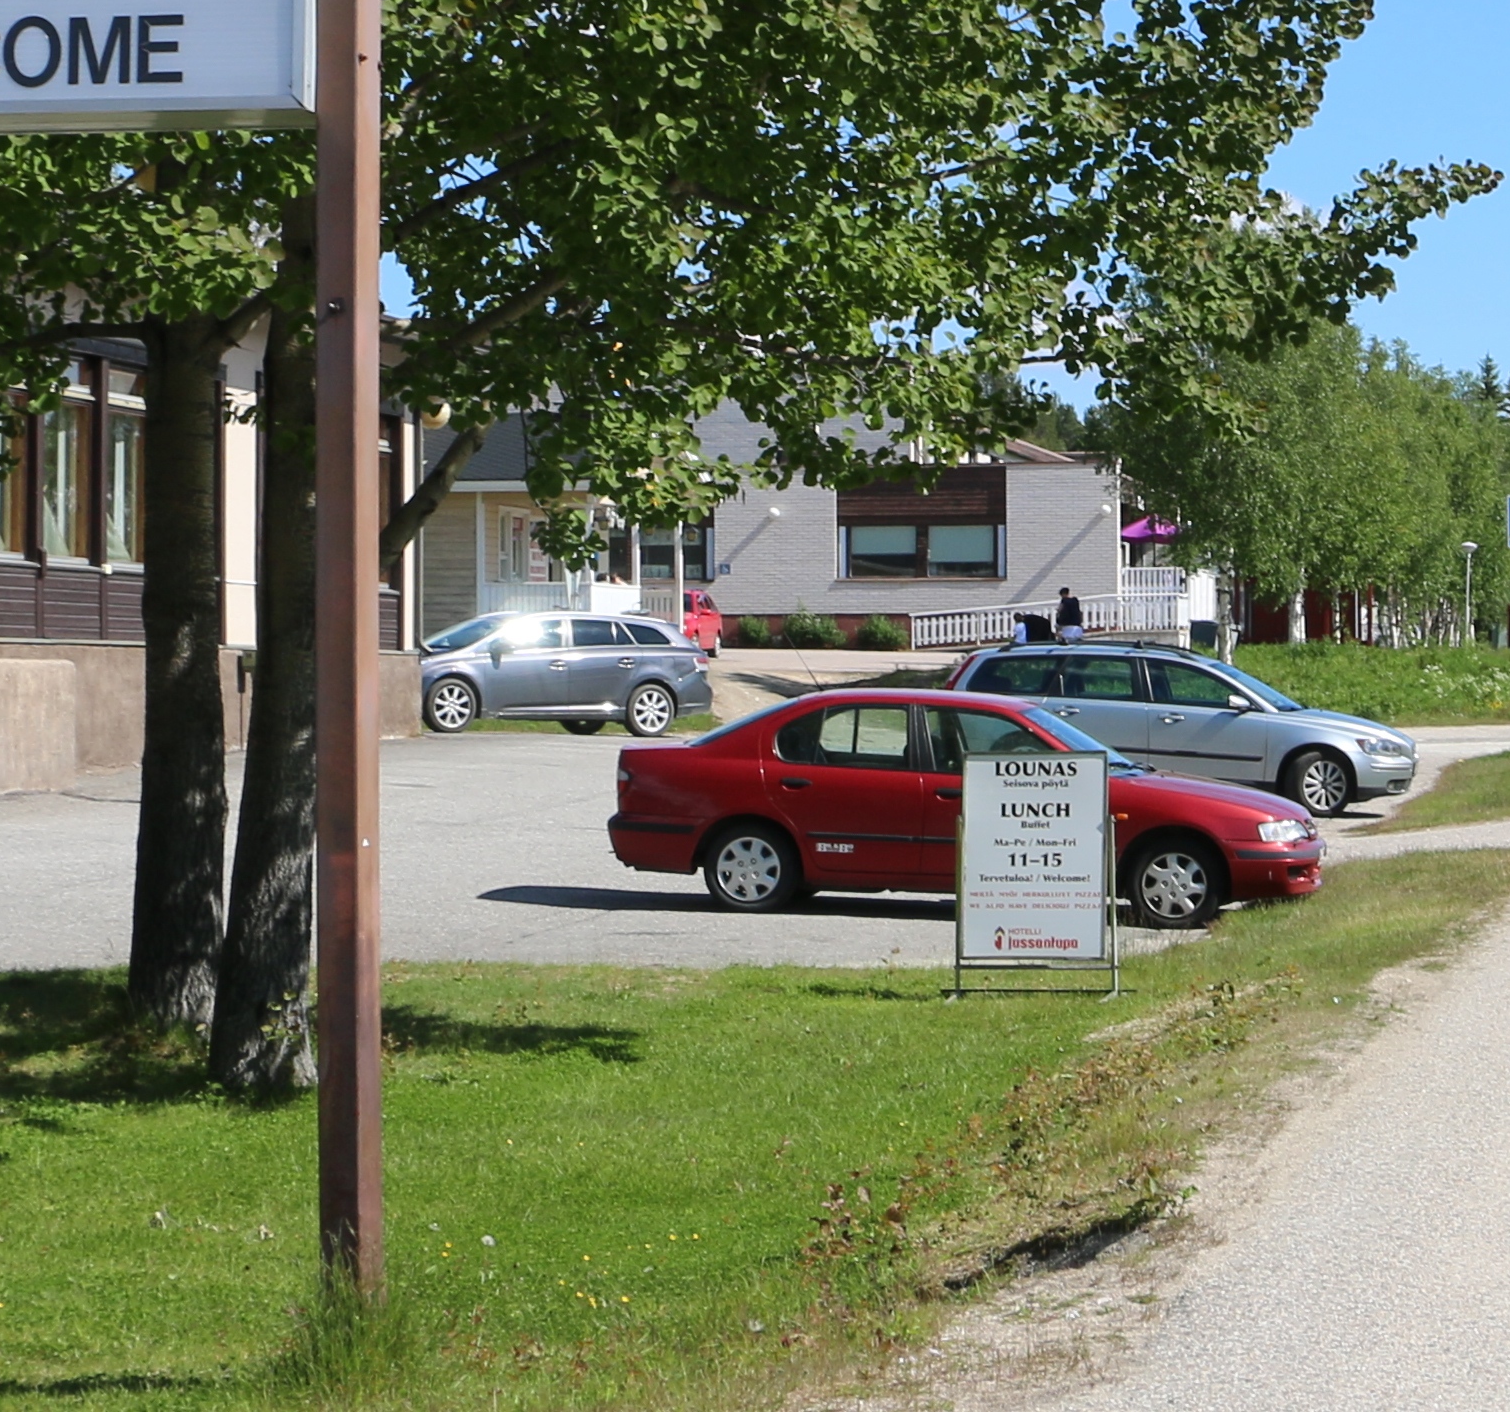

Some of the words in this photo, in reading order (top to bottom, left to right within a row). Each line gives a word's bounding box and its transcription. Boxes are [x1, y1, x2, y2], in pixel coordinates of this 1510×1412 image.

[995, 761, 1078, 777] LOUNAS
[1003, 779, 1039, 788] Seisova
[1042, 778, 1069, 790] pöytä
[1000, 802, 1071, 818] LUNCH
[1021, 820, 1051, 829] Buffet
[979, 873, 1034, 883] Tervetuloa!
[1042, 873, 1091, 883] Welcome!
